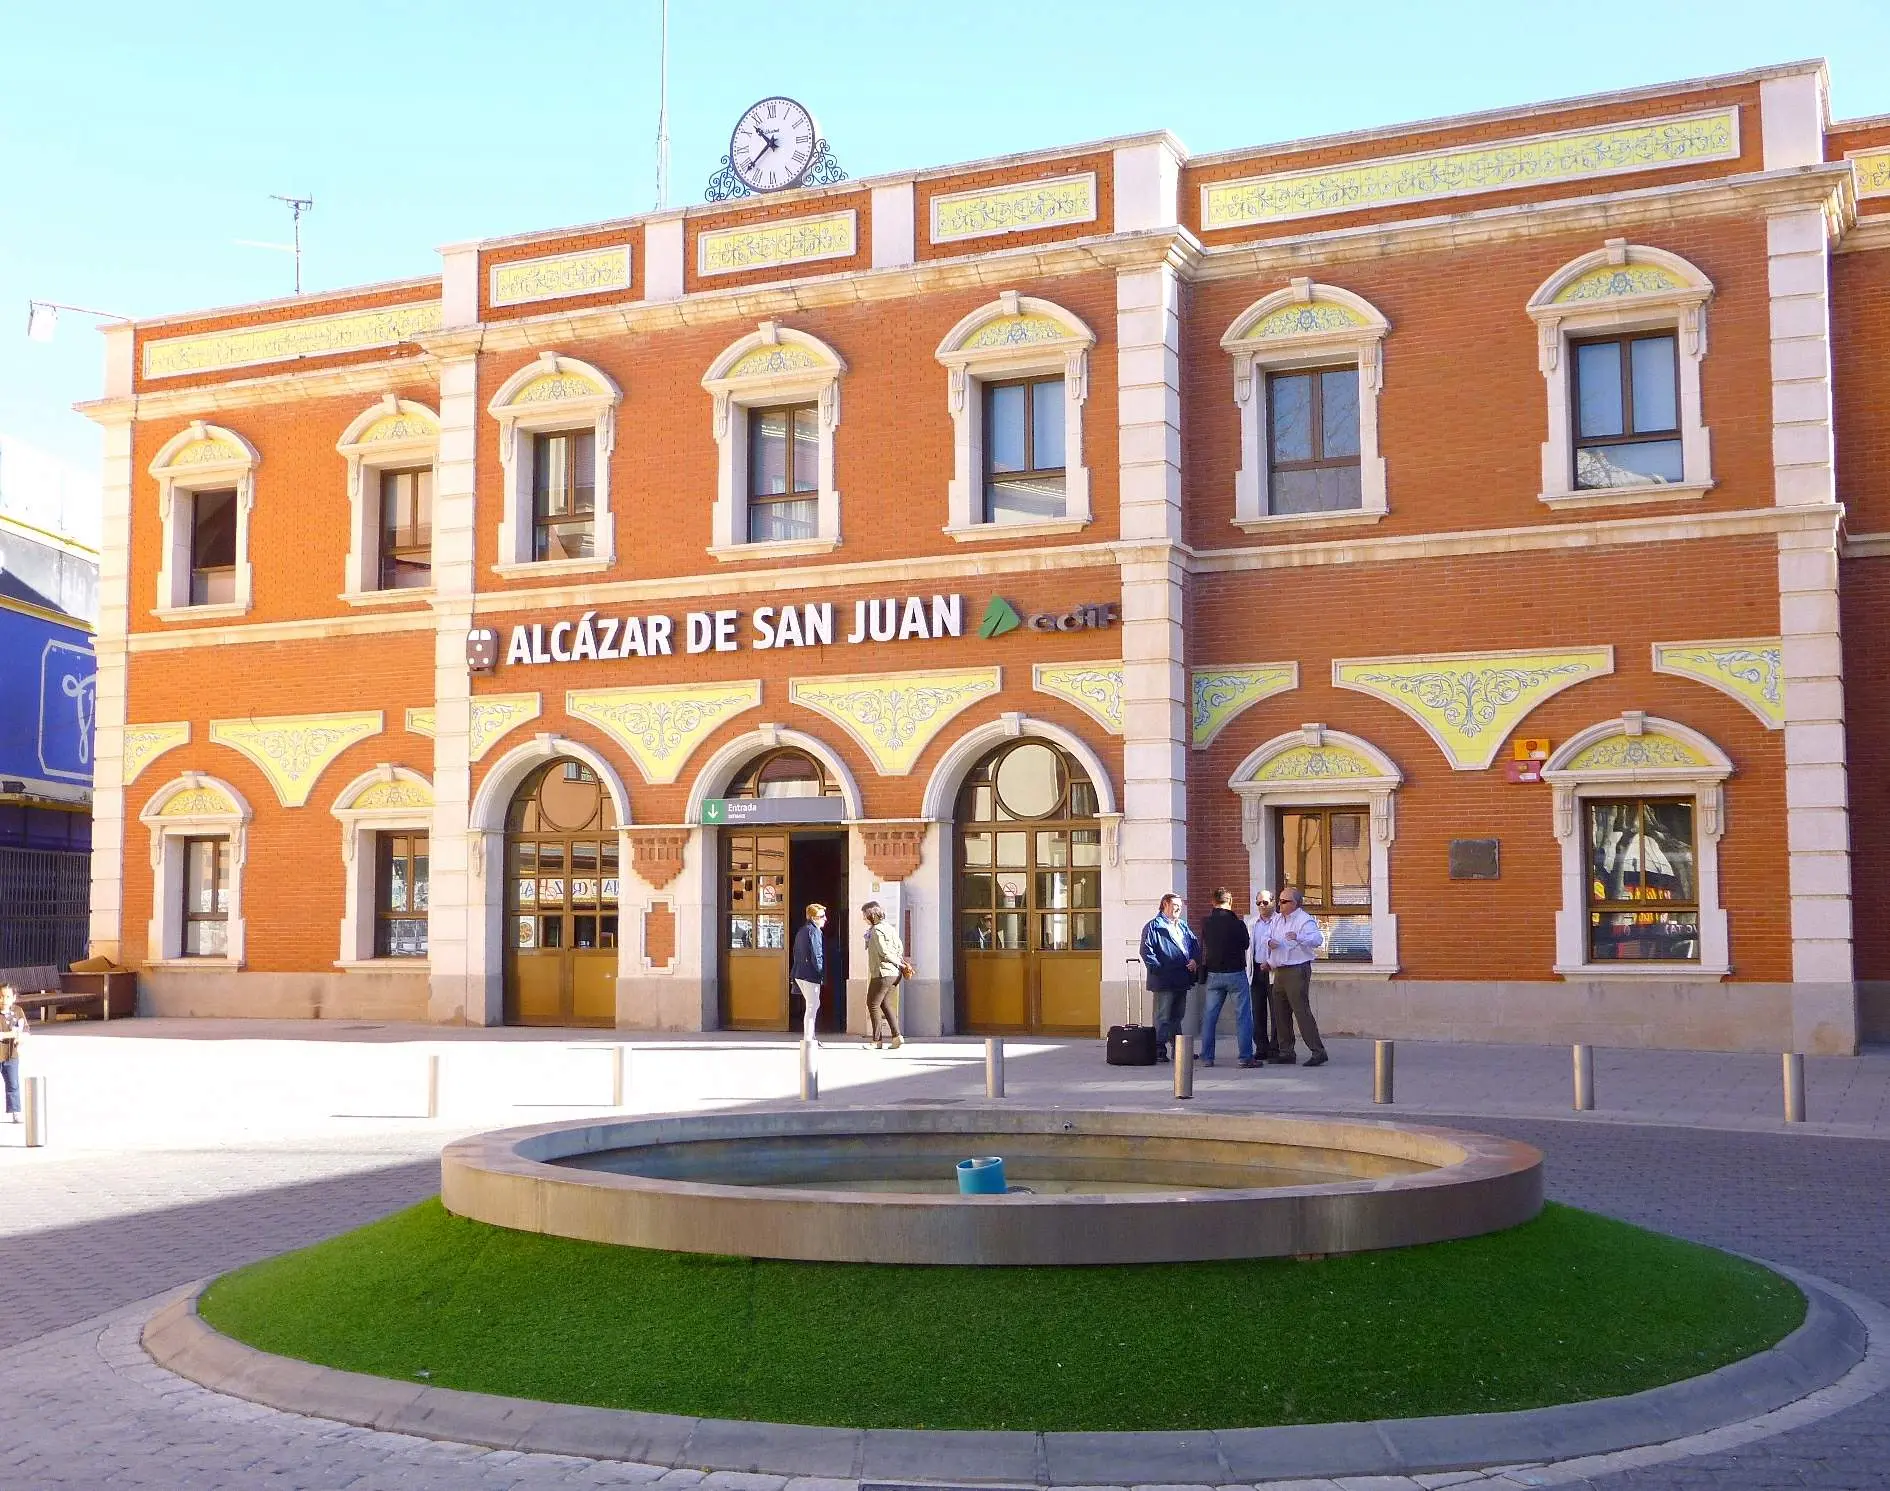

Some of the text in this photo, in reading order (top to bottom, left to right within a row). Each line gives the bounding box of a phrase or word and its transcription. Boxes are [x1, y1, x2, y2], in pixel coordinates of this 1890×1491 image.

[506, 594, 961, 665] ALCÁZAR DE SAN JUAN
[728, 803, 757, 812] Entrada
